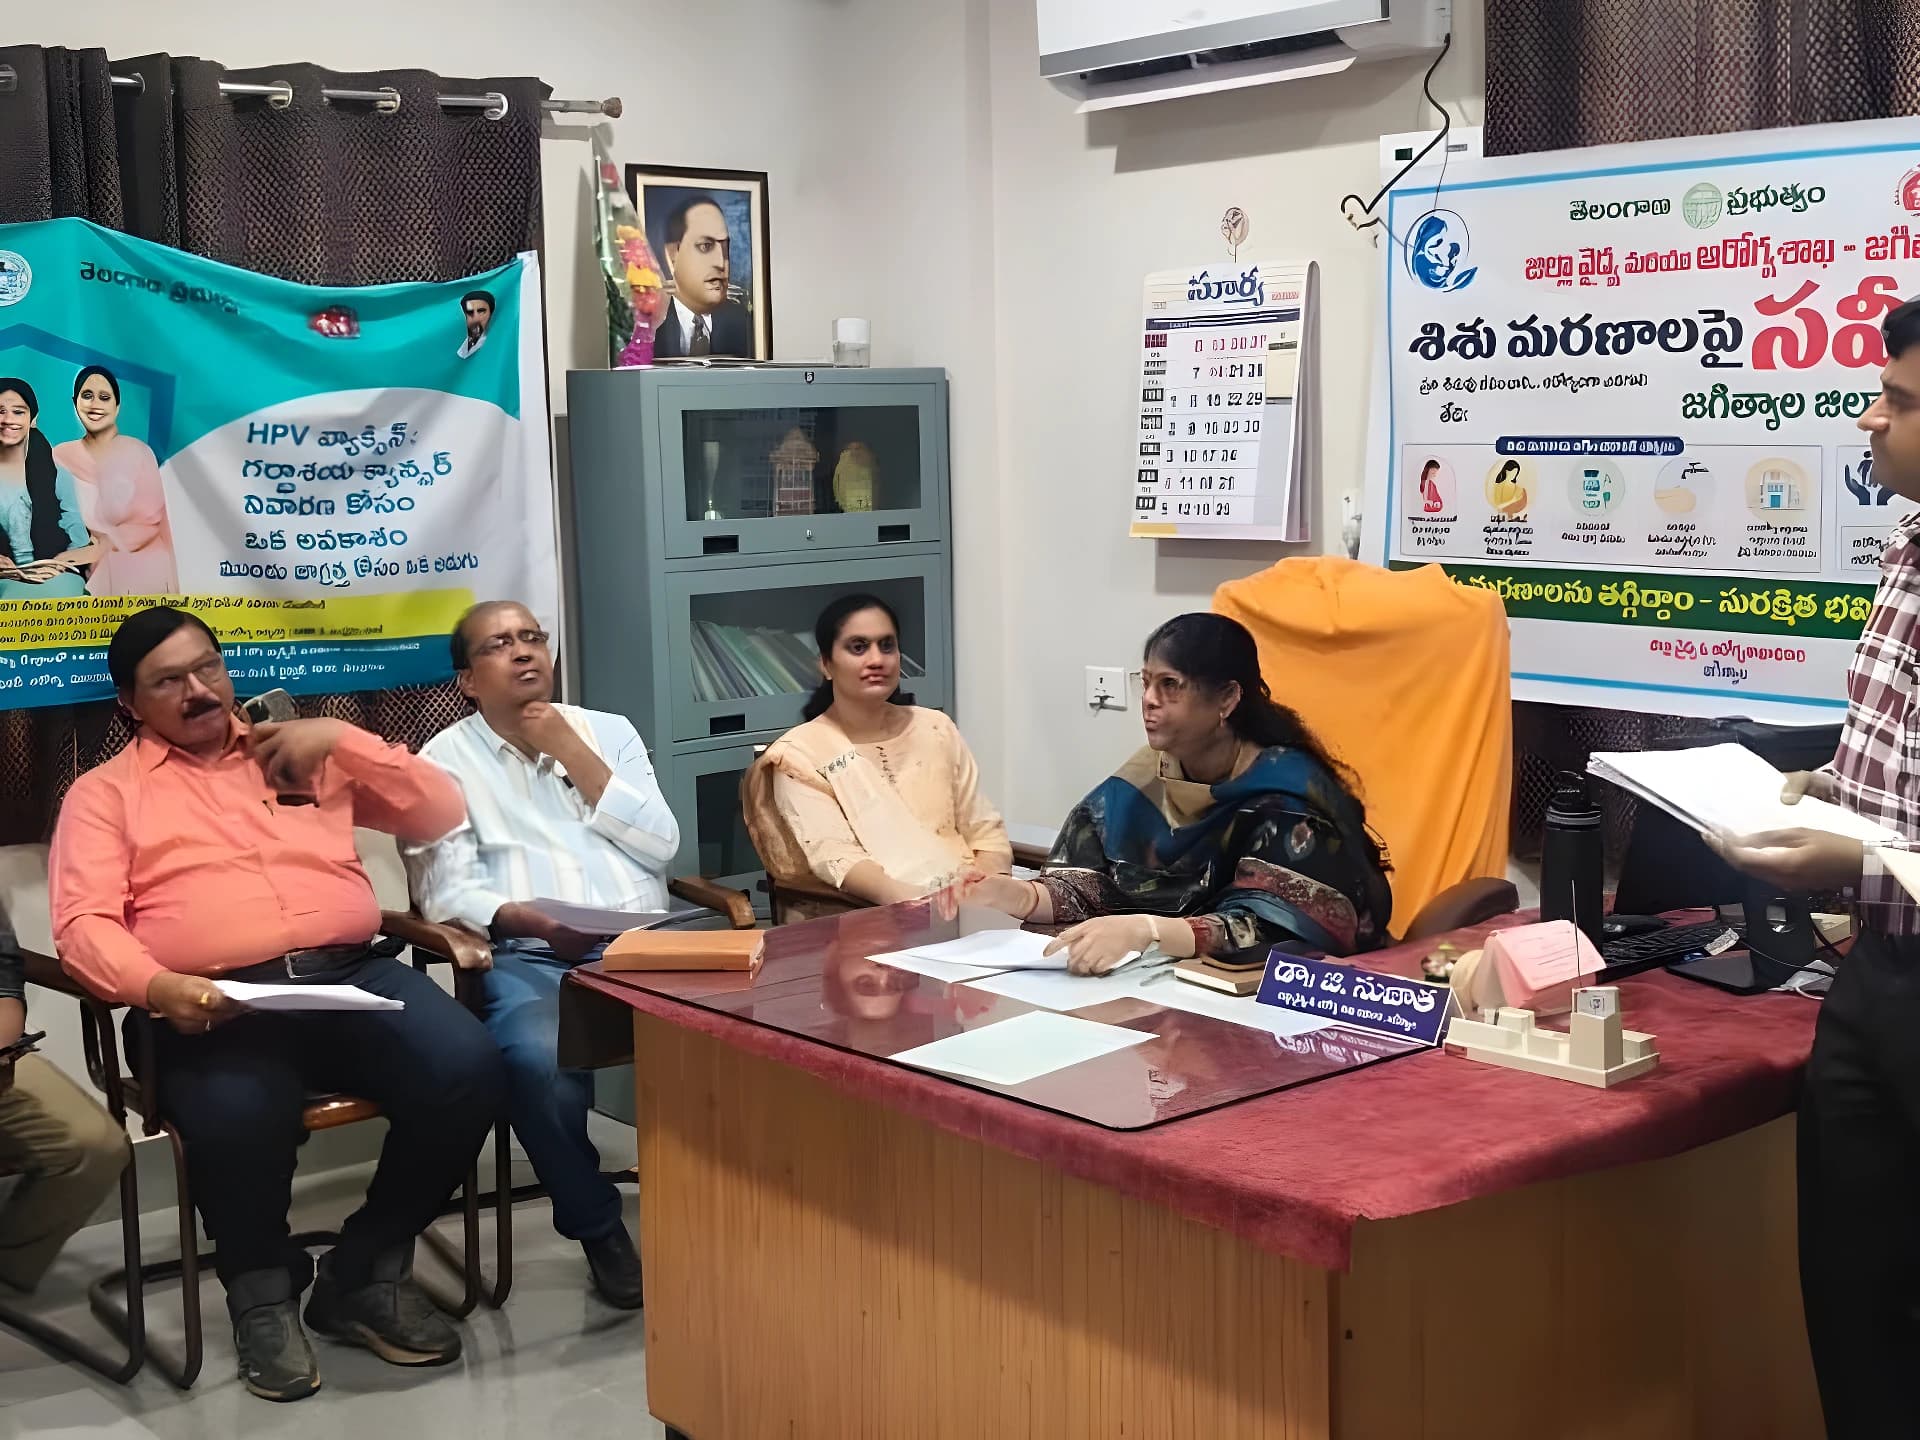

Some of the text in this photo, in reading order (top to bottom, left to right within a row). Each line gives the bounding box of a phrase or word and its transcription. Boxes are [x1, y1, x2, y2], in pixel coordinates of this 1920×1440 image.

[1727, 183, 1826, 215] ప్రభుత్వం
[1408, 316, 1497, 361] శిశు
[1507, 310, 1744, 369] మరణాలపై
[1682, 382, 1806, 431] జగిత్యాల
[247, 422, 310, 446] HPV
[296, 527, 408, 551] అవకాశం
